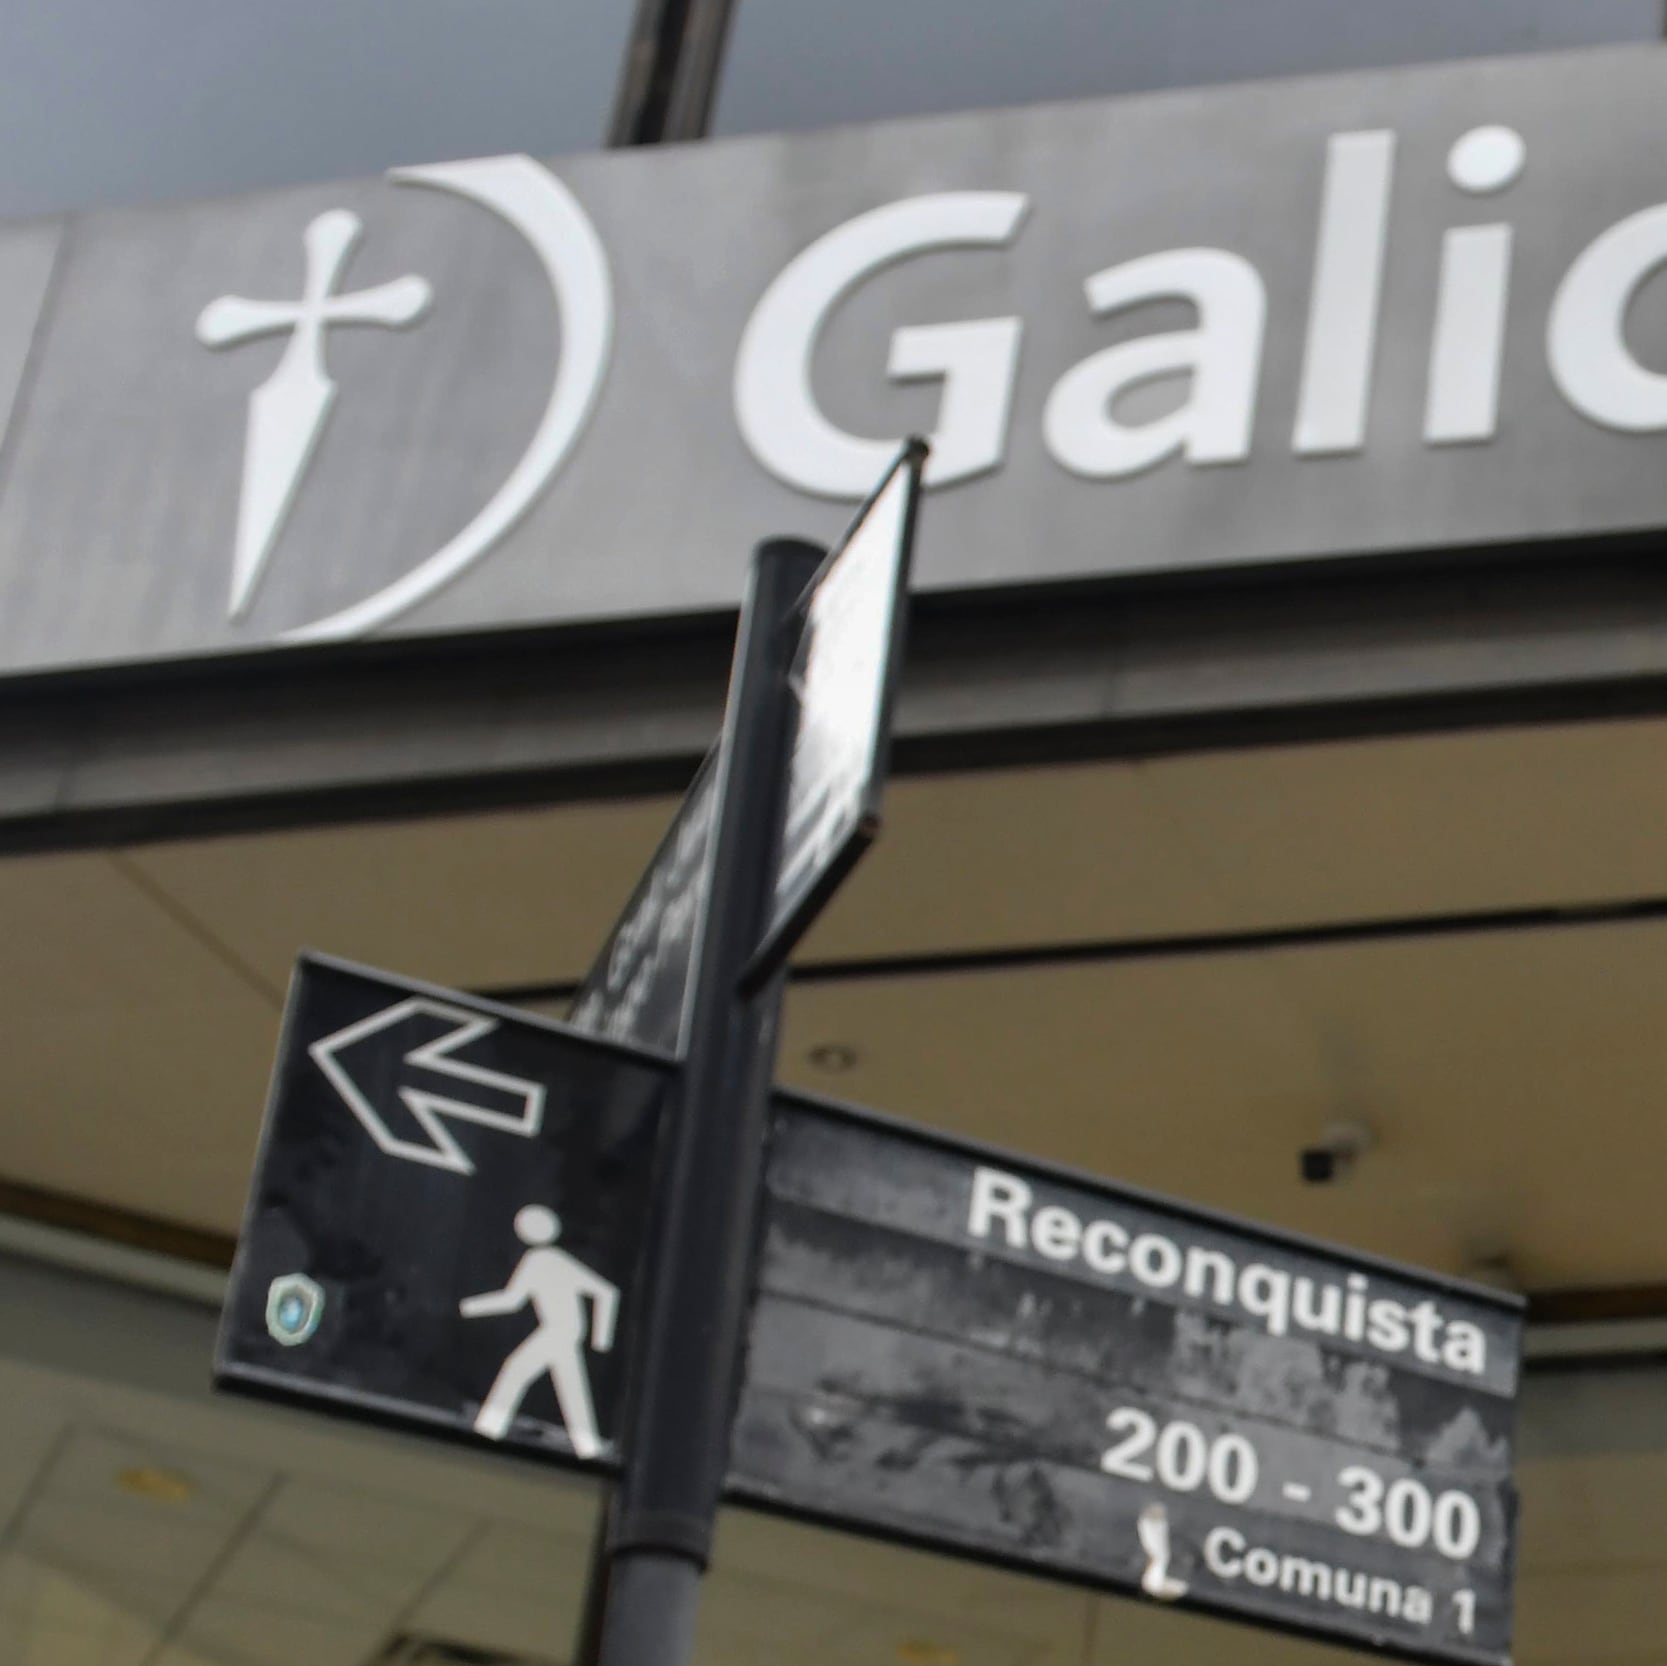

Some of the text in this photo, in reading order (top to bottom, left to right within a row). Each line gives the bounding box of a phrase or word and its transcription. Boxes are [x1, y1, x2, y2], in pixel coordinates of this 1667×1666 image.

[967, 1168, 1487, 1376] Reconquista
[1101, 1407, 1481, 1559] 200 - 300
[1203, 1526, 1477, 1634] Comuna 1
